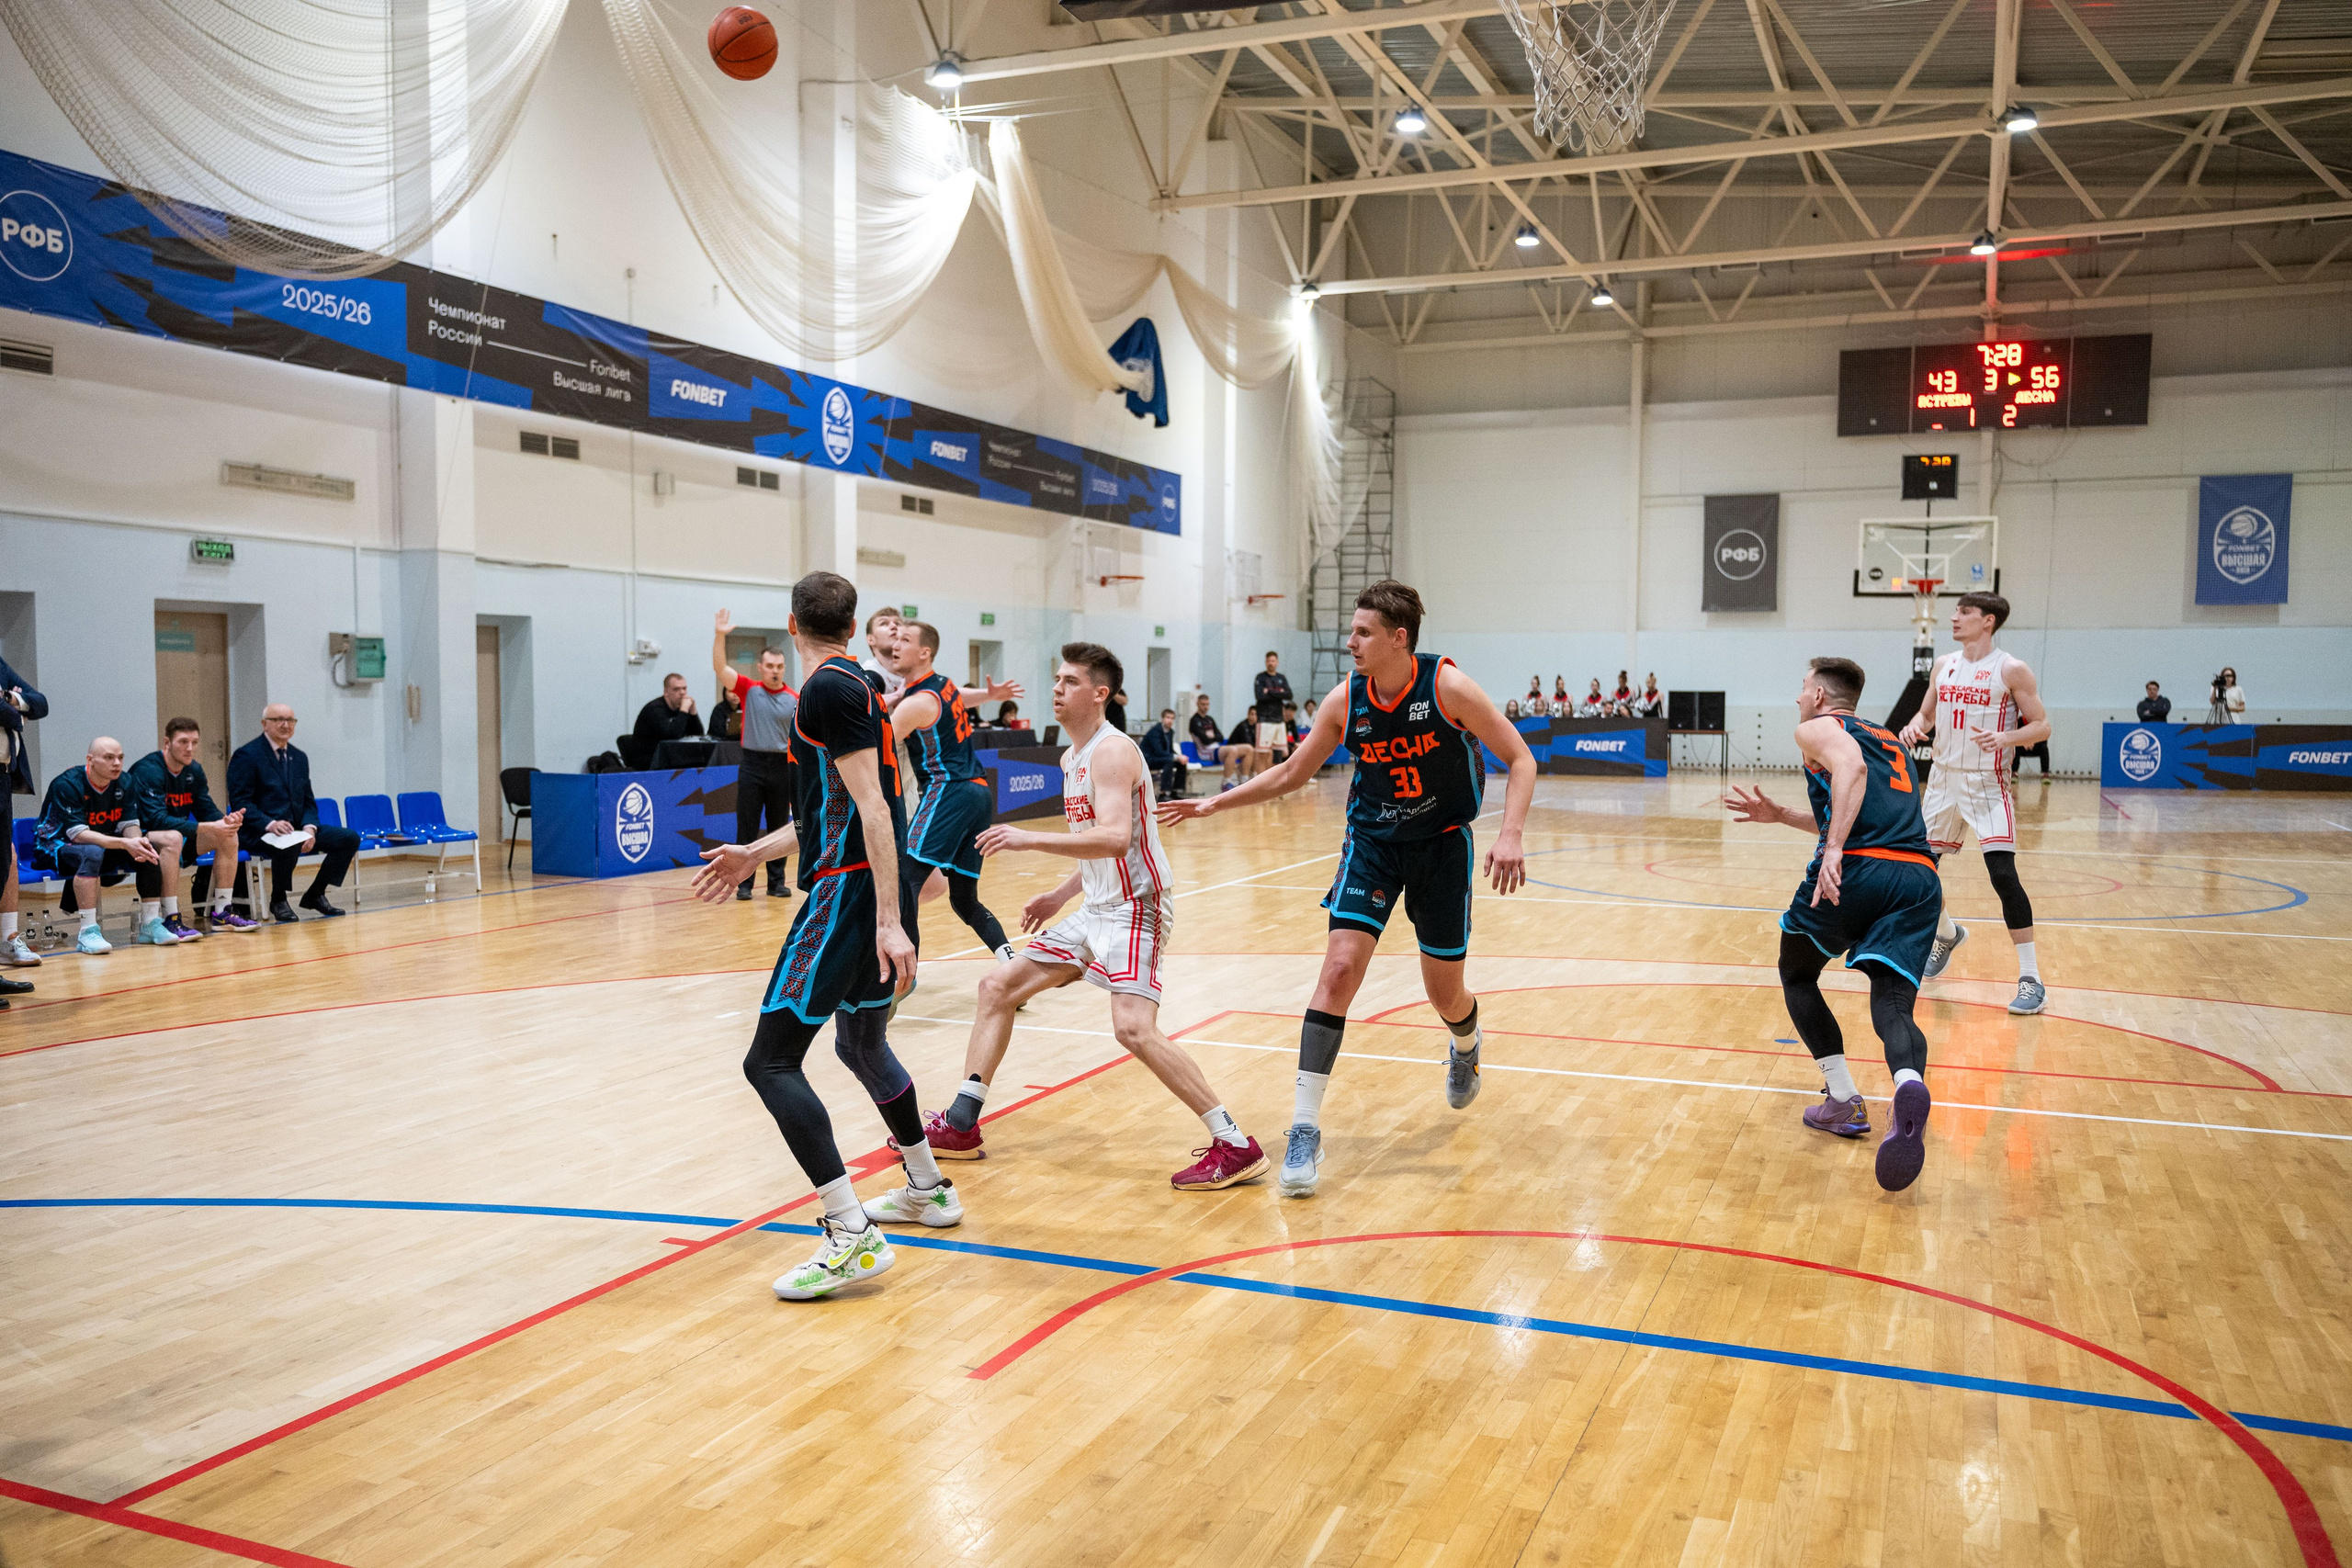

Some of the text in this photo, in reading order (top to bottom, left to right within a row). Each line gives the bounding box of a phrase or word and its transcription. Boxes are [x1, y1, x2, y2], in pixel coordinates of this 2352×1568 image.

[2, 217, 64, 254] РФБ
[282, 284, 372, 325] 2025/26
[428, 296, 506, 331] Чемпионат
[428, 319, 482, 346] России
[1977, 344, 2021, 367] 7:28
[590, 358, 631, 383] Fonbet
[1928, 366, 2060, 393] 43 3 56
[553, 370, 631, 402] Высшая лига
[671, 378, 727, 408] FONBET
[2003, 404, 2018, 427] 2
[931, 441, 967, 462] FONBET
[1721, 547, 1760, 563] РФБ
[2222, 553, 2267, 567] ВЫСШАЯ
[1408, 710, 1430, 722] BET
[1409, 701, 1430, 713] FON
[1953, 708, 1964, 730] 11
[1360, 731, 1441, 763] ДЕСНА
[1575, 739, 1627, 752] FONBET
[1882, 741, 1913, 794] 3
[2288, 751, 2352, 764] FONBET
[1010, 774, 1045, 792] 2025/26
[1390, 766, 1422, 798] 33
[621, 830, 649, 847] ВЫСШАЯ
[1346, 887, 1365, 897] TEAM
